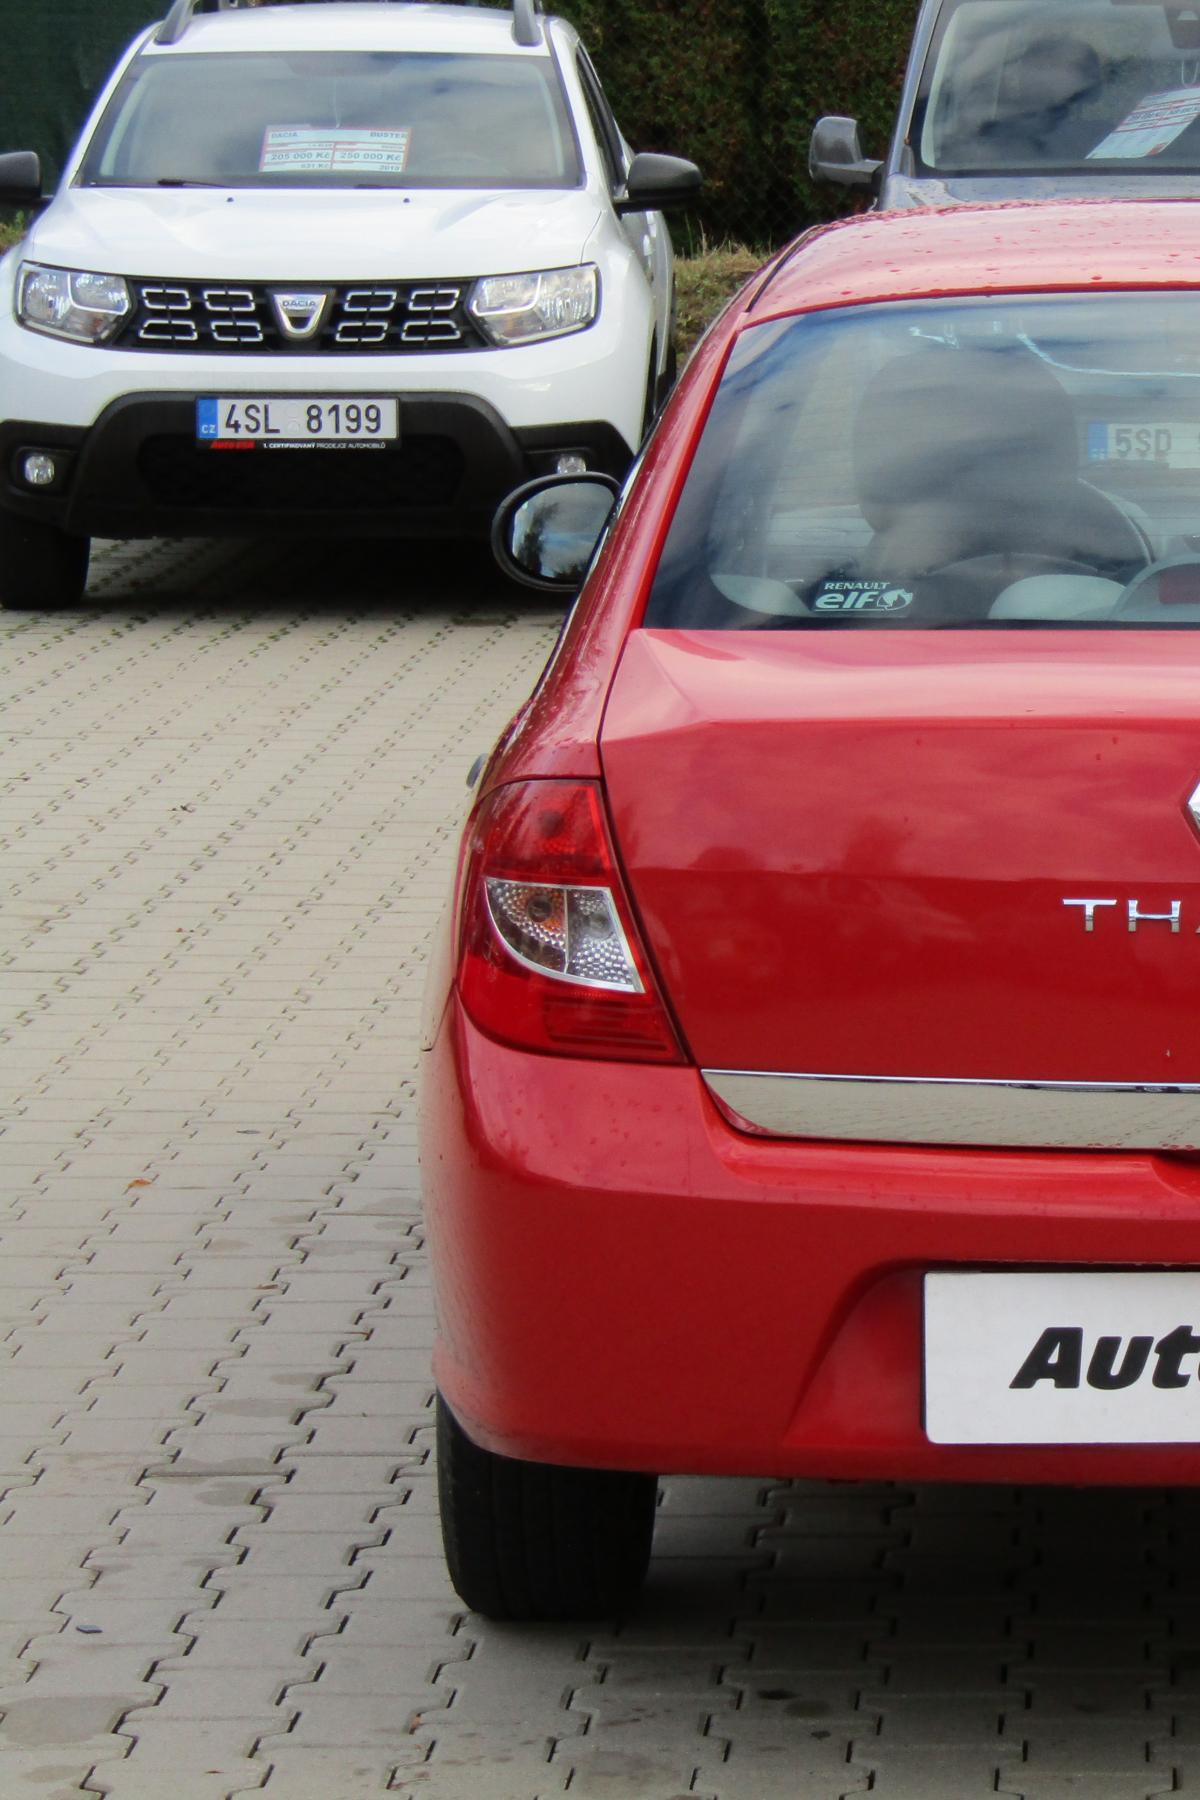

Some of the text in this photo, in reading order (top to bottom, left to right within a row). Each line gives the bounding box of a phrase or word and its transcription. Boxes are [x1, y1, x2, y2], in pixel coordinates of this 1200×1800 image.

[293, 151, 313, 160] 000
[363, 152, 384, 160] 000
[225, 404, 381, 434] 4SL 8199
[201, 425, 216, 434] CZ
[824, 582, 890, 590] RENAULT
[815, 591, 879, 609] elf
